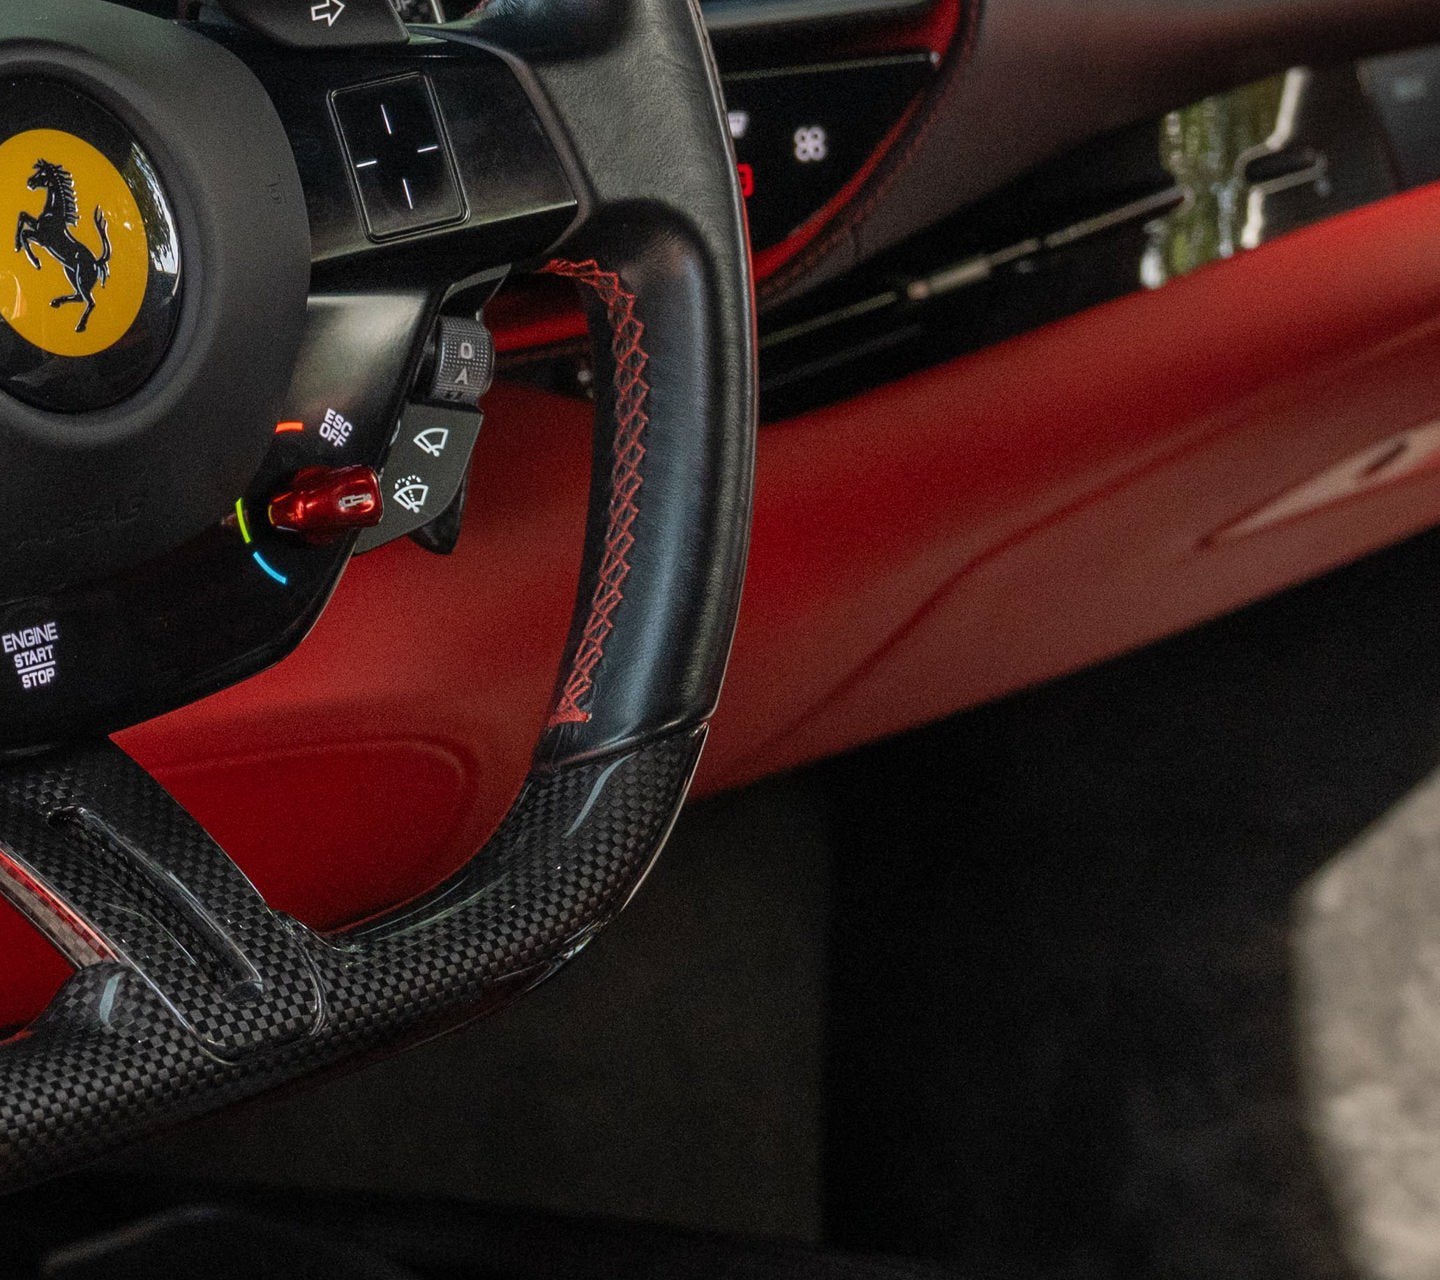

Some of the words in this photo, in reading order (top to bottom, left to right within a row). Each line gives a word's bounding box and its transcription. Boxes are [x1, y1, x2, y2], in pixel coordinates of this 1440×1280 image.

[319, 421, 347, 448] OFF
[323, 407, 353, 438] ESC
[1, 621, 58, 653] ENGINE
[13, 644, 53, 668] START
[21, 666, 55, 689] STOP
